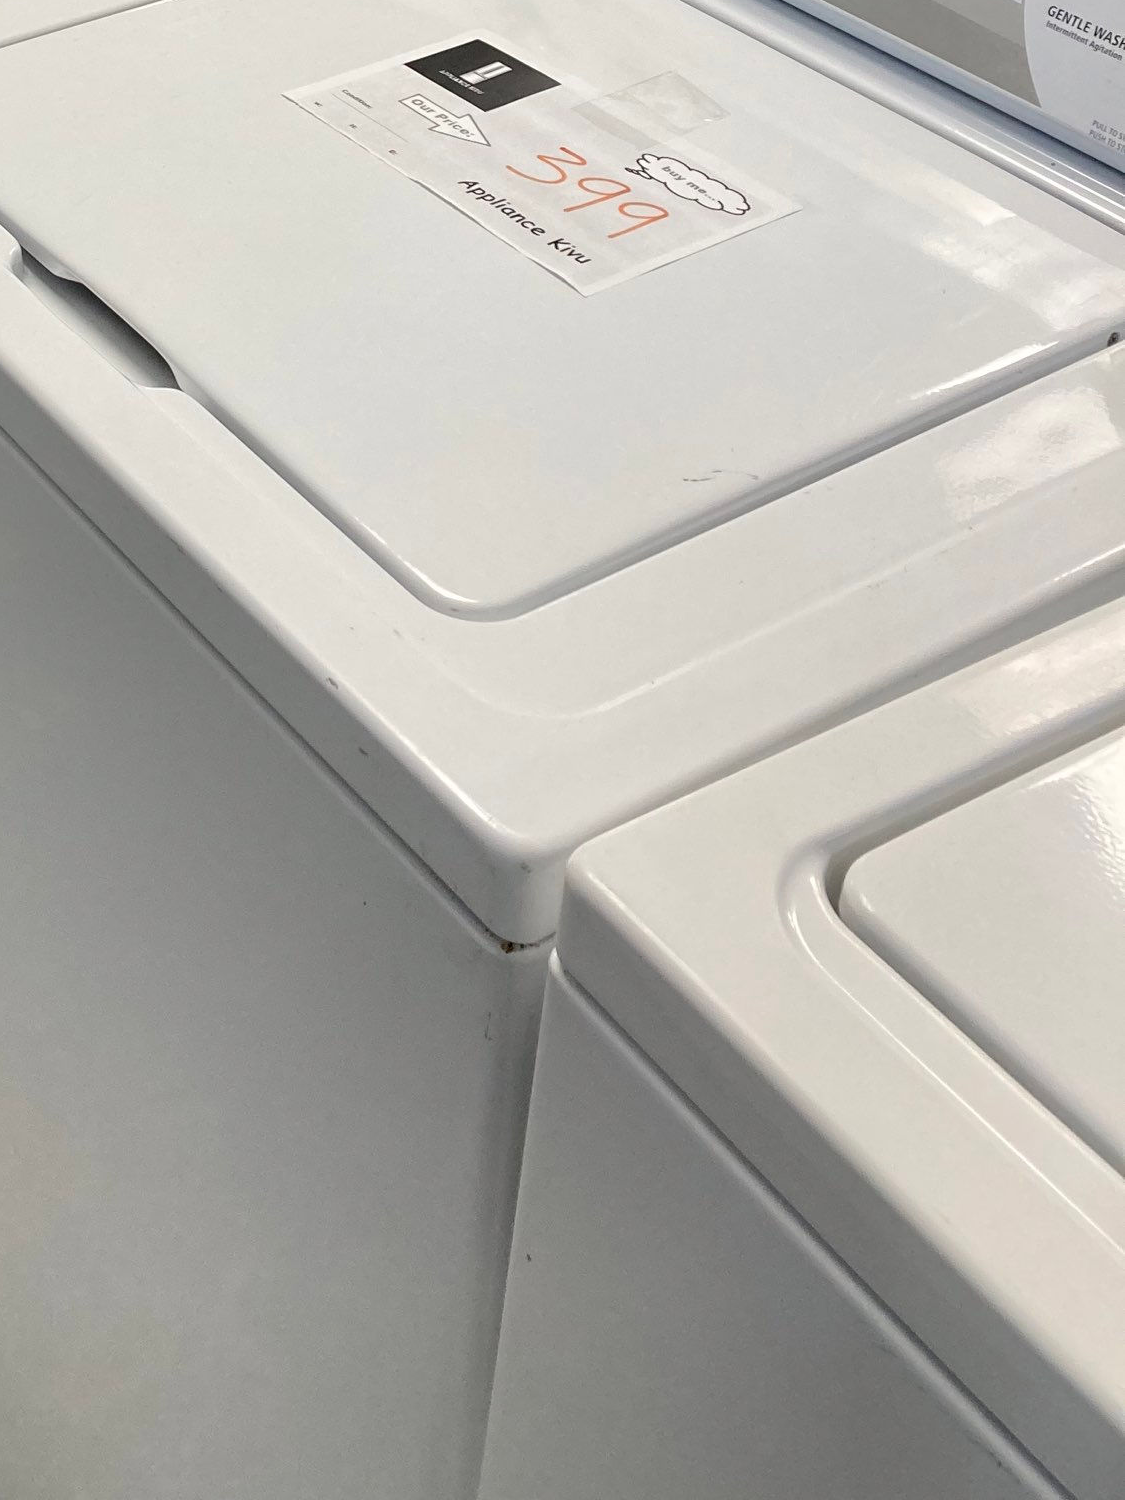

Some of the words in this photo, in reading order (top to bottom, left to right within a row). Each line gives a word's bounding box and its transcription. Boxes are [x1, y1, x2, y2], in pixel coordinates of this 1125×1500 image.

[1047, 5, 1092, 33] GENTLE
[1045, 20, 1089, 46] Intermittent
[1088, 40, 1123, 61] Agitation
[411, 98, 435, 115] Our
[435, 112, 475, 138] Price:
[505, 146, 669, 239] 399
[661, 165, 686, 185] buy
[457, 180, 546, 237] Appliance
[547, 237, 592, 264] Kivu
